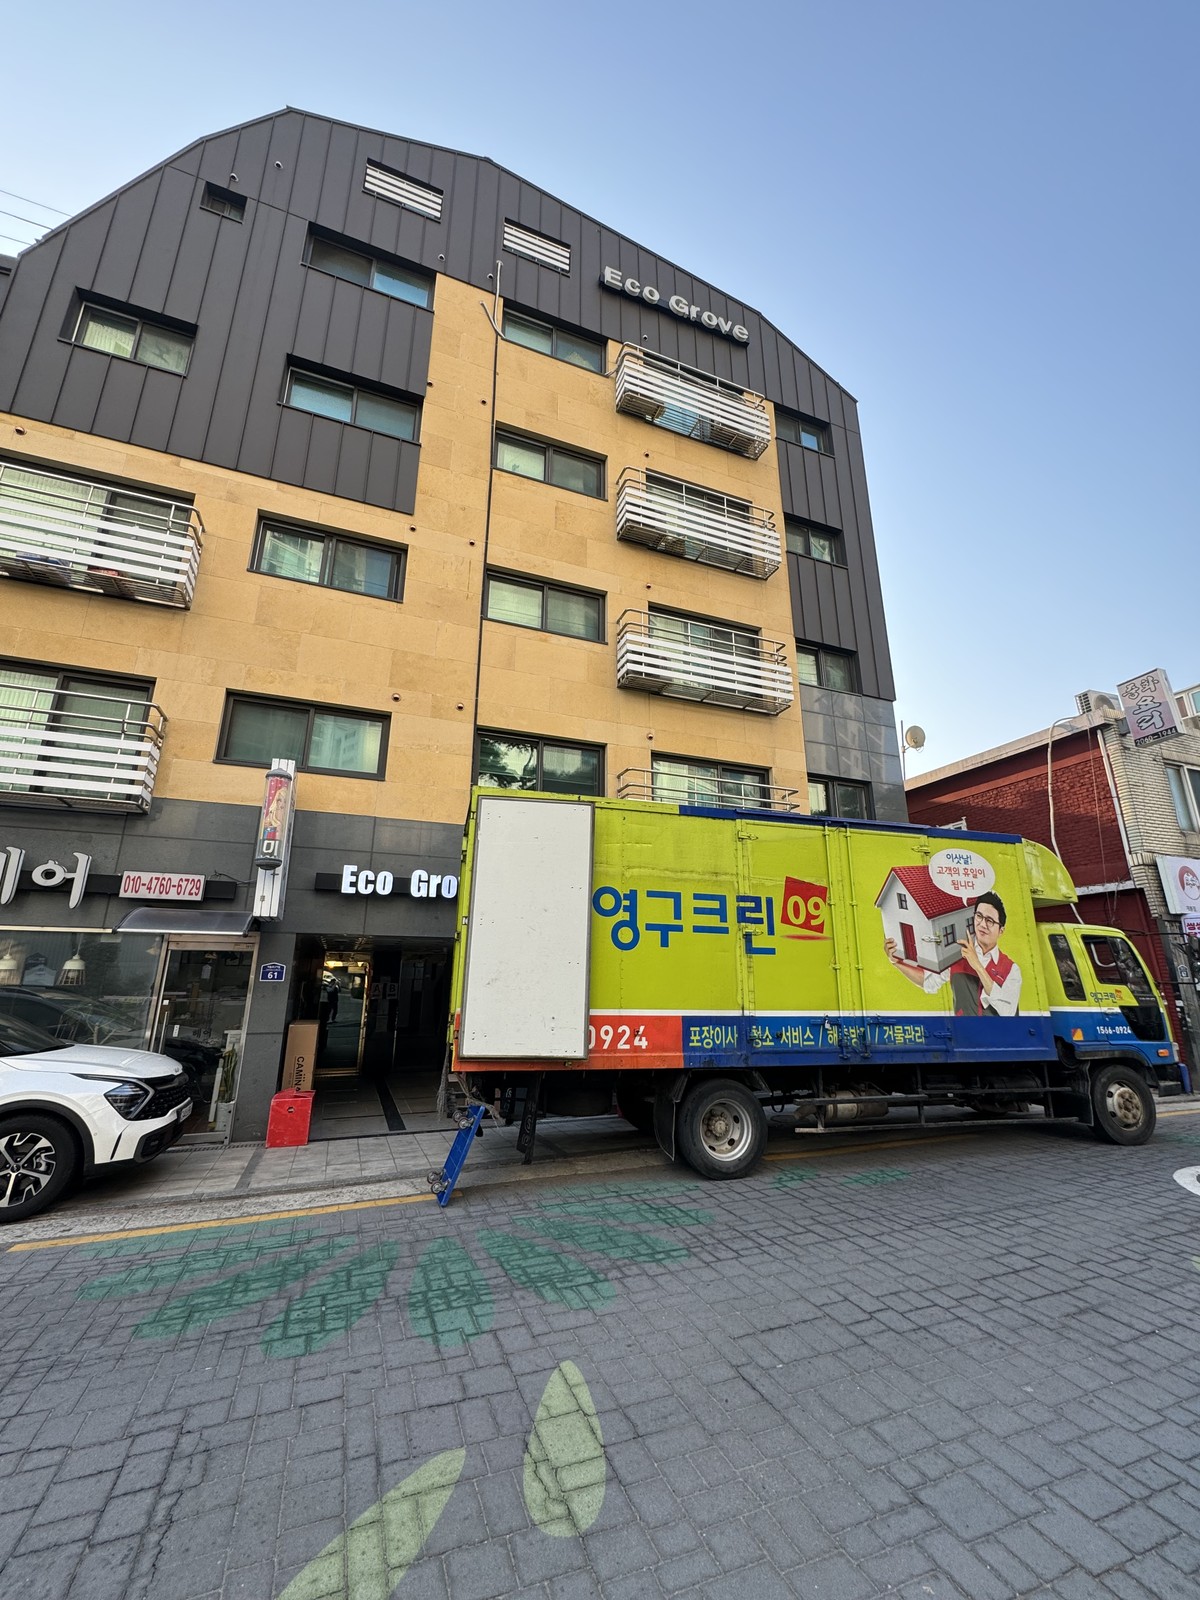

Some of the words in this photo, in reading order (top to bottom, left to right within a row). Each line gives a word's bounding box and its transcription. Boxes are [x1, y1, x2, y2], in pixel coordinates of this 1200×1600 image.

[604, 265, 660, 305] Eco
[668, 294, 749, 342] Grove
[1135, 727, 1177, 746] 2060-1944
[946, 853, 973, 865] 이삿날!
[341, 864, 394, 896] Eco
[410, 869, 460, 899] Gro
[937, 866, 960, 877] 고객의
[962, 867, 986, 879] 휴일이
[123, 874, 202, 897] 010-4760-6729
[951, 880, 975, 890] 됩니다
[592, 885, 776, 955] 영구크린
[786, 894, 826, 926] 09
[267, 971, 278, 979] 61
[689, 1025, 738, 1049] 포장이사
[751, 1025, 775, 1048] 청소
[780, 1025, 815, 1048] 서비스
[883, 1025, 925, 1045] 건물관리
[1096, 1026, 1132, 1035] 1566-0924
